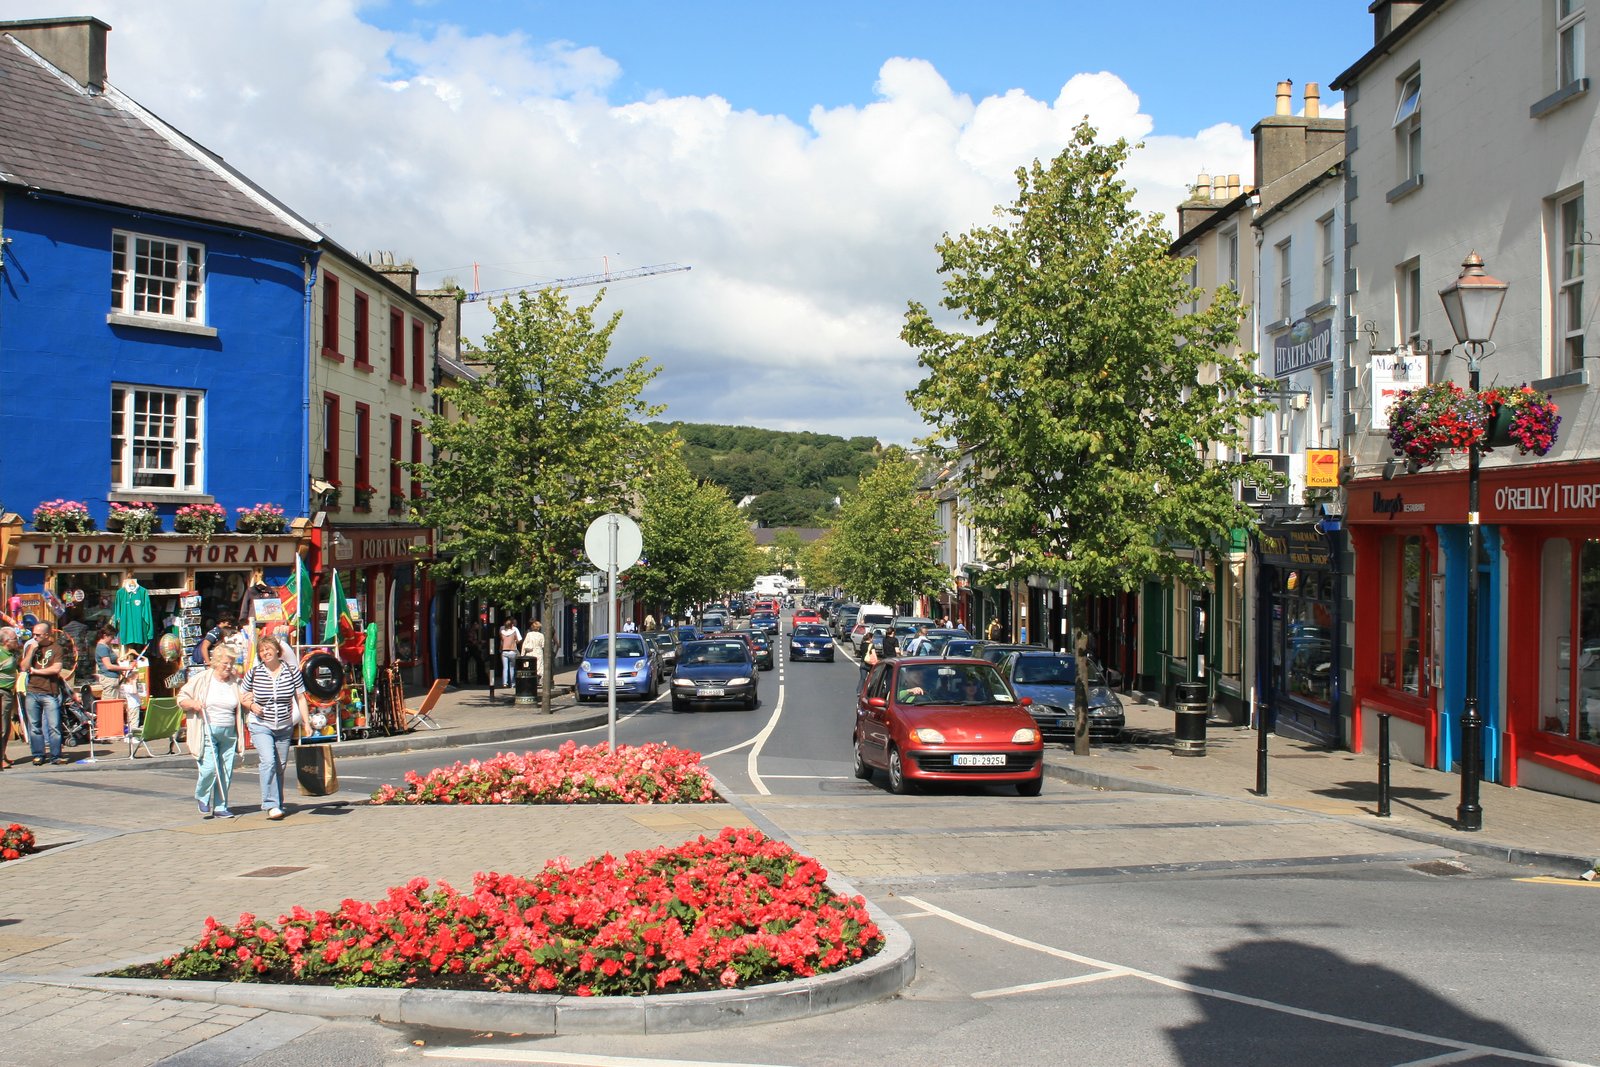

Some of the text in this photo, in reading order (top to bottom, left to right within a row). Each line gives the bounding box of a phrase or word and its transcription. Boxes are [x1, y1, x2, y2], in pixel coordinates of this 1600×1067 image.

[1276, 329, 1330, 374] HEALTH SHOP
[1375, 358, 1423, 375] Mango's
[1495, 486, 1551, 511] O'REILLY
[33, 543, 279, 564] THOMAS MORAN
[362, 538, 412, 559] PORTWEST
[1291, 552, 1328, 564] HEALTH SHOP
[958, 756, 1005, 765] 00-D-29254
